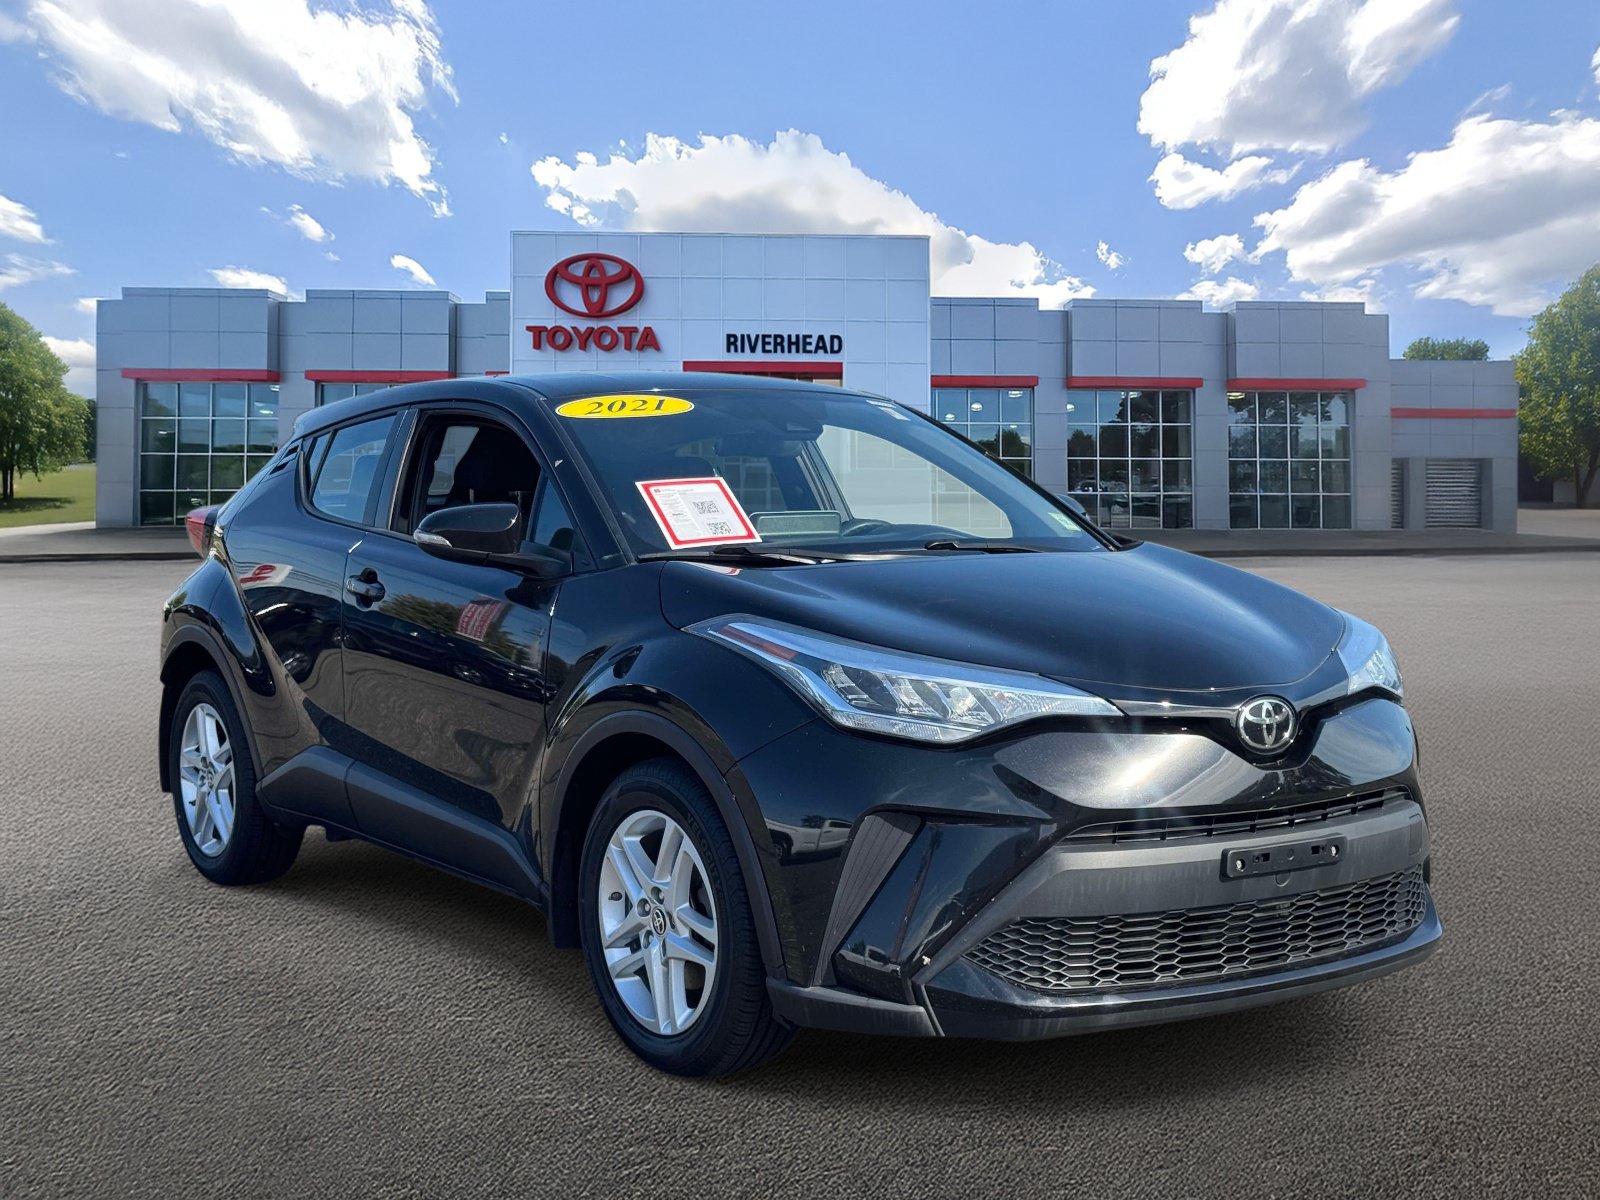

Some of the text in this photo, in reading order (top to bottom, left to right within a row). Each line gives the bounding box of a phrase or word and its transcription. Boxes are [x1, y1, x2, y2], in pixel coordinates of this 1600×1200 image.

[526, 325, 660, 351] TOYOTA
[726, 333, 843, 354] RIVERHEAD
[585, 399, 666, 415] 2021
